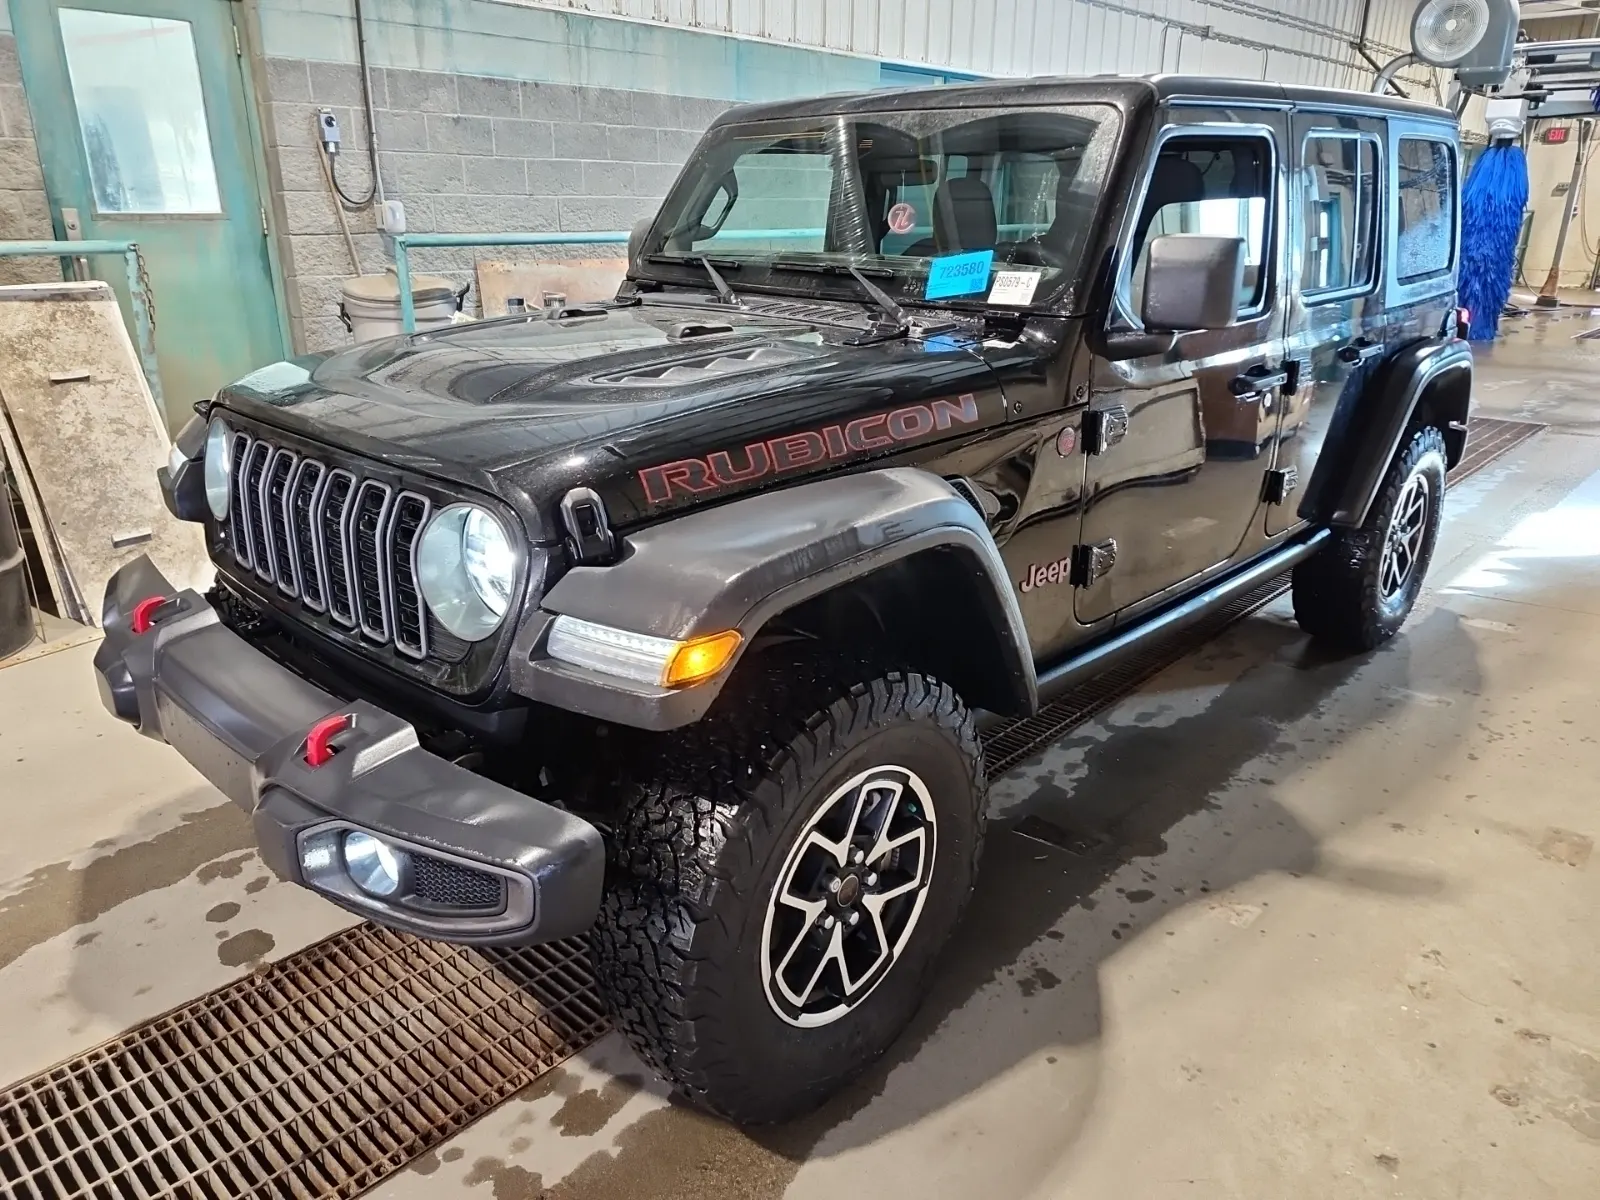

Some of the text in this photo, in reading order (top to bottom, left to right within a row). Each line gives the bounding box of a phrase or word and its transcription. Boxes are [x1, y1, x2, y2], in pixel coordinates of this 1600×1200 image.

[1549, 129, 1566, 140] EXIT
[939, 261, 985, 279] 723580
[638, 393, 979, 503] RUBICON
[1019, 557, 1071, 593] Jeep
